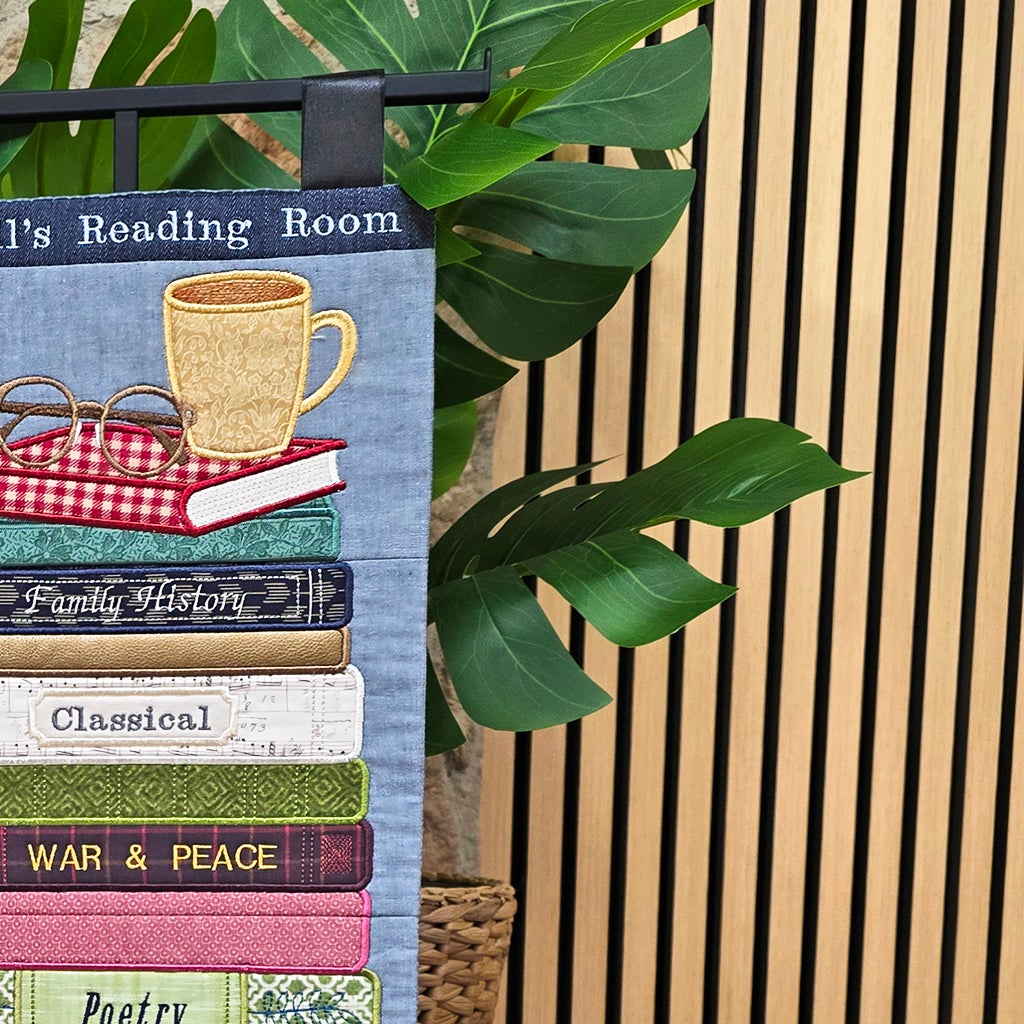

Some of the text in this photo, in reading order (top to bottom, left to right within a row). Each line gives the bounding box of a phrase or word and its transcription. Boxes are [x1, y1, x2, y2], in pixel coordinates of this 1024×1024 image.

[77, 211, 252, 249] Reading
[280, 205, 403, 238] Room
[25, 578, 248, 621] Family History
[51, 706, 212, 732] Classical
[27, 843, 278, 872] WAR & PEACE
